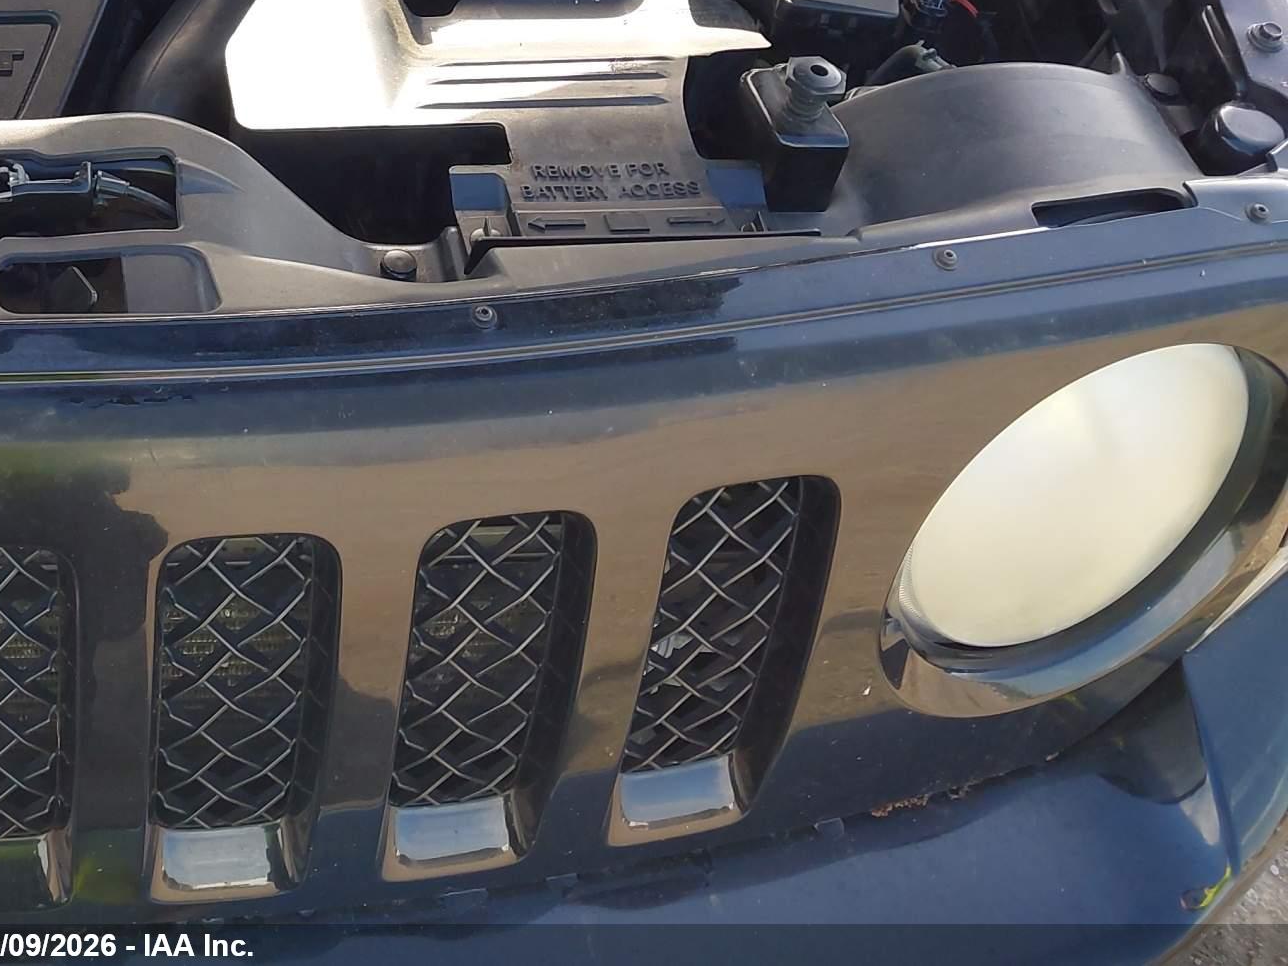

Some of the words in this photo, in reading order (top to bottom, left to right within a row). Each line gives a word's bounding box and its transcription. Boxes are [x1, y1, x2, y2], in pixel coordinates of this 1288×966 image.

[532, 162, 622, 181] REMOVE
[626, 161, 671, 178] FOR
[520, 185, 609, 202] BATTERY
[618, 181, 702, 199] ACCESS
